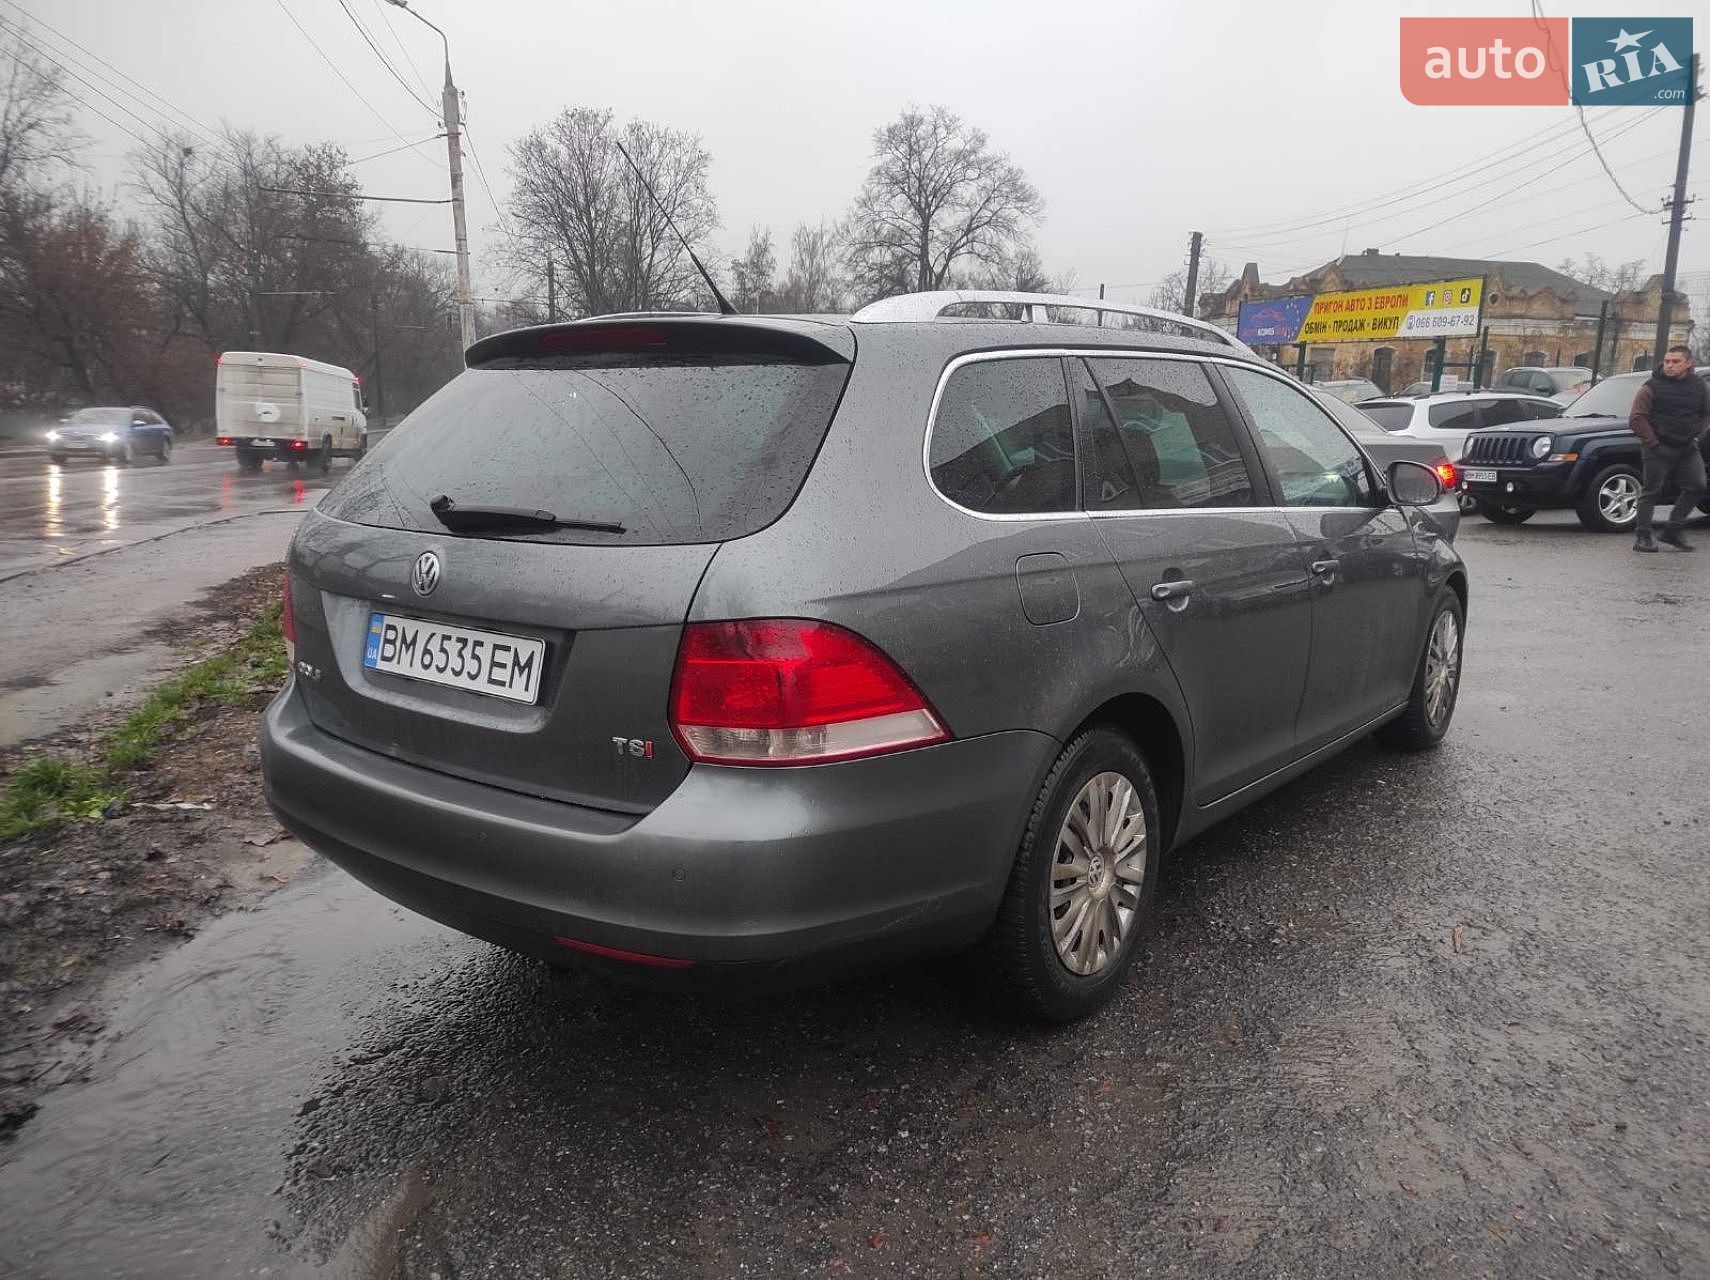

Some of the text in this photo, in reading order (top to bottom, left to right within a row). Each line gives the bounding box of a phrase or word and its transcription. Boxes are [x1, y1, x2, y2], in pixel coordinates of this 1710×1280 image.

[1314, 299, 1344, 315] ПРИГОН
[1345, 297, 1366, 312] АВТО
[1374, 293, 1409, 310] ЕВРОПИ
[1304, 319, 1327, 335] ОБМІН
[1332, 317, 1366, 334] ПРОДАЖ
[1372, 315, 1400, 331] ВИКУП
[1416, 314, 1475, 328] 066 609-67-92
[367, 646, 377, 660] UA
